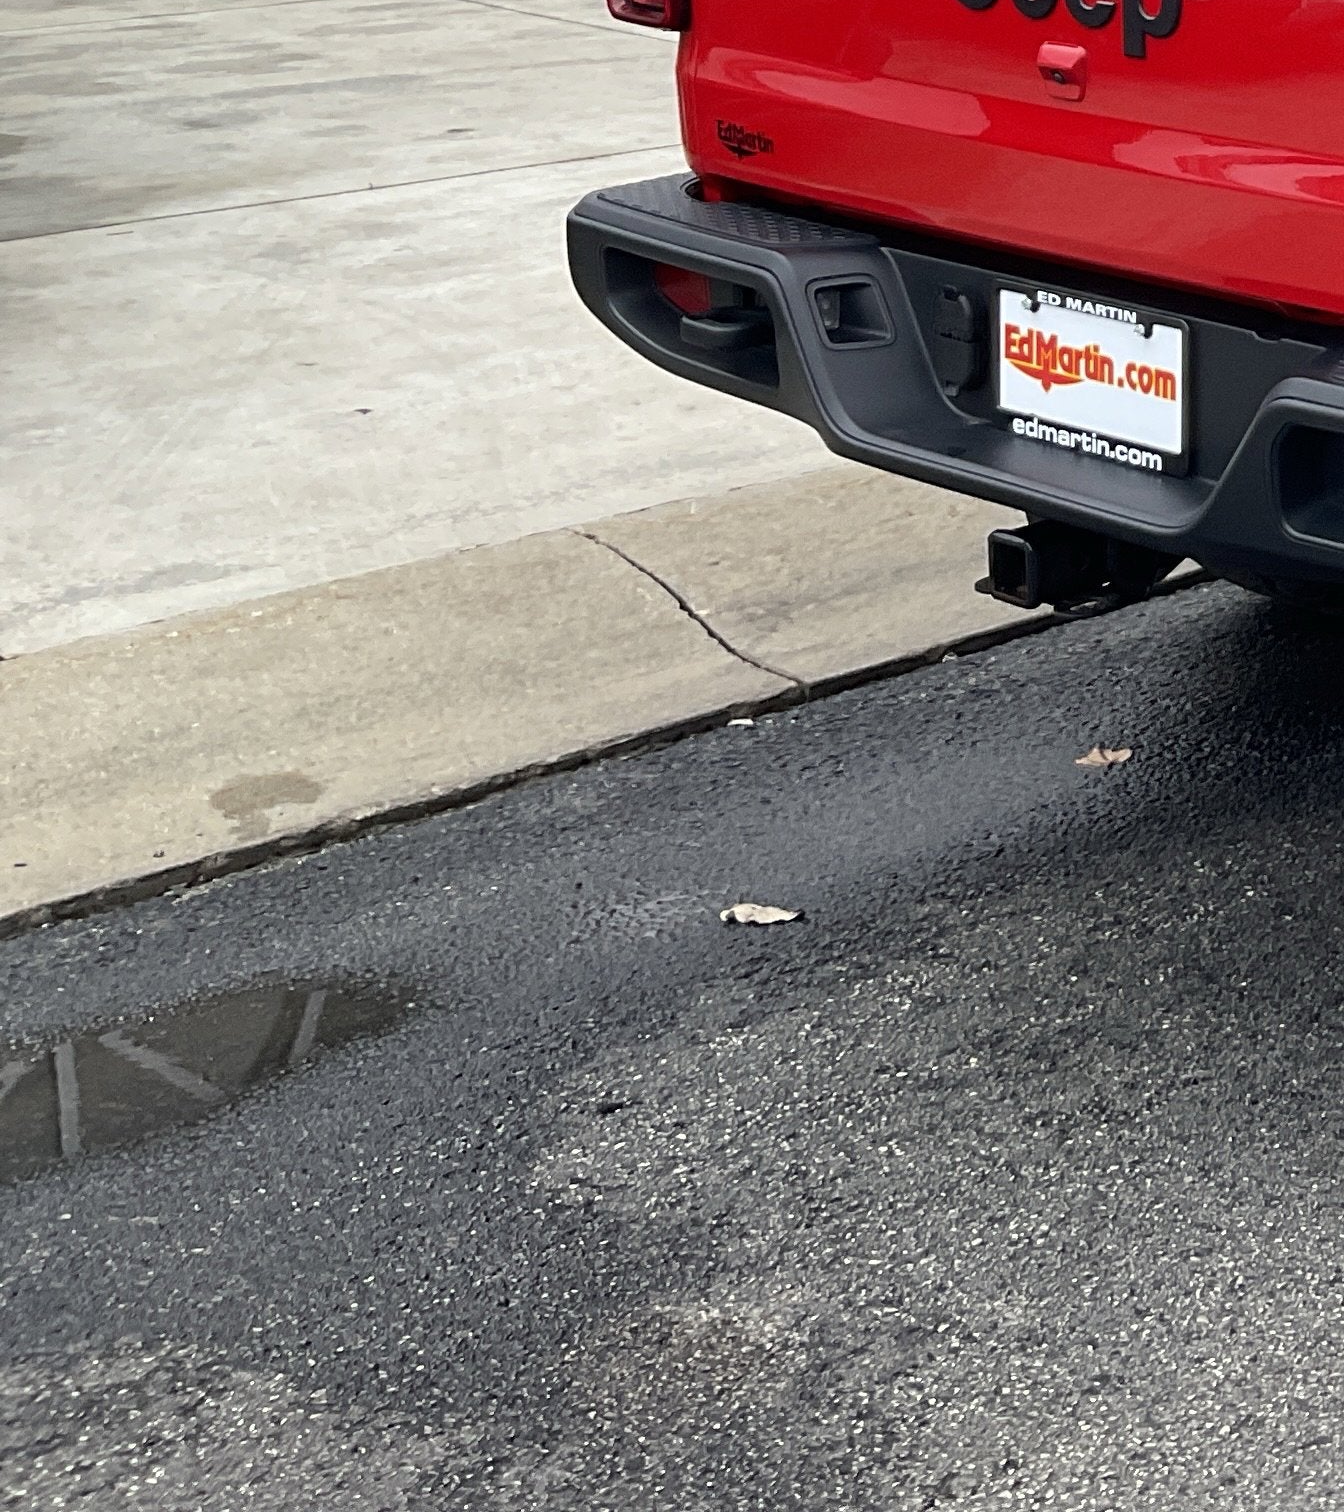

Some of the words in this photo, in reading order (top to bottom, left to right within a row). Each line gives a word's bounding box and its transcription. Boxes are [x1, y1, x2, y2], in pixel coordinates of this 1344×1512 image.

[1038, 291, 1061, 306] ED
[1067, 297, 1136, 323] MARTIN
[1013, 417, 1162, 471] edmartin.com
